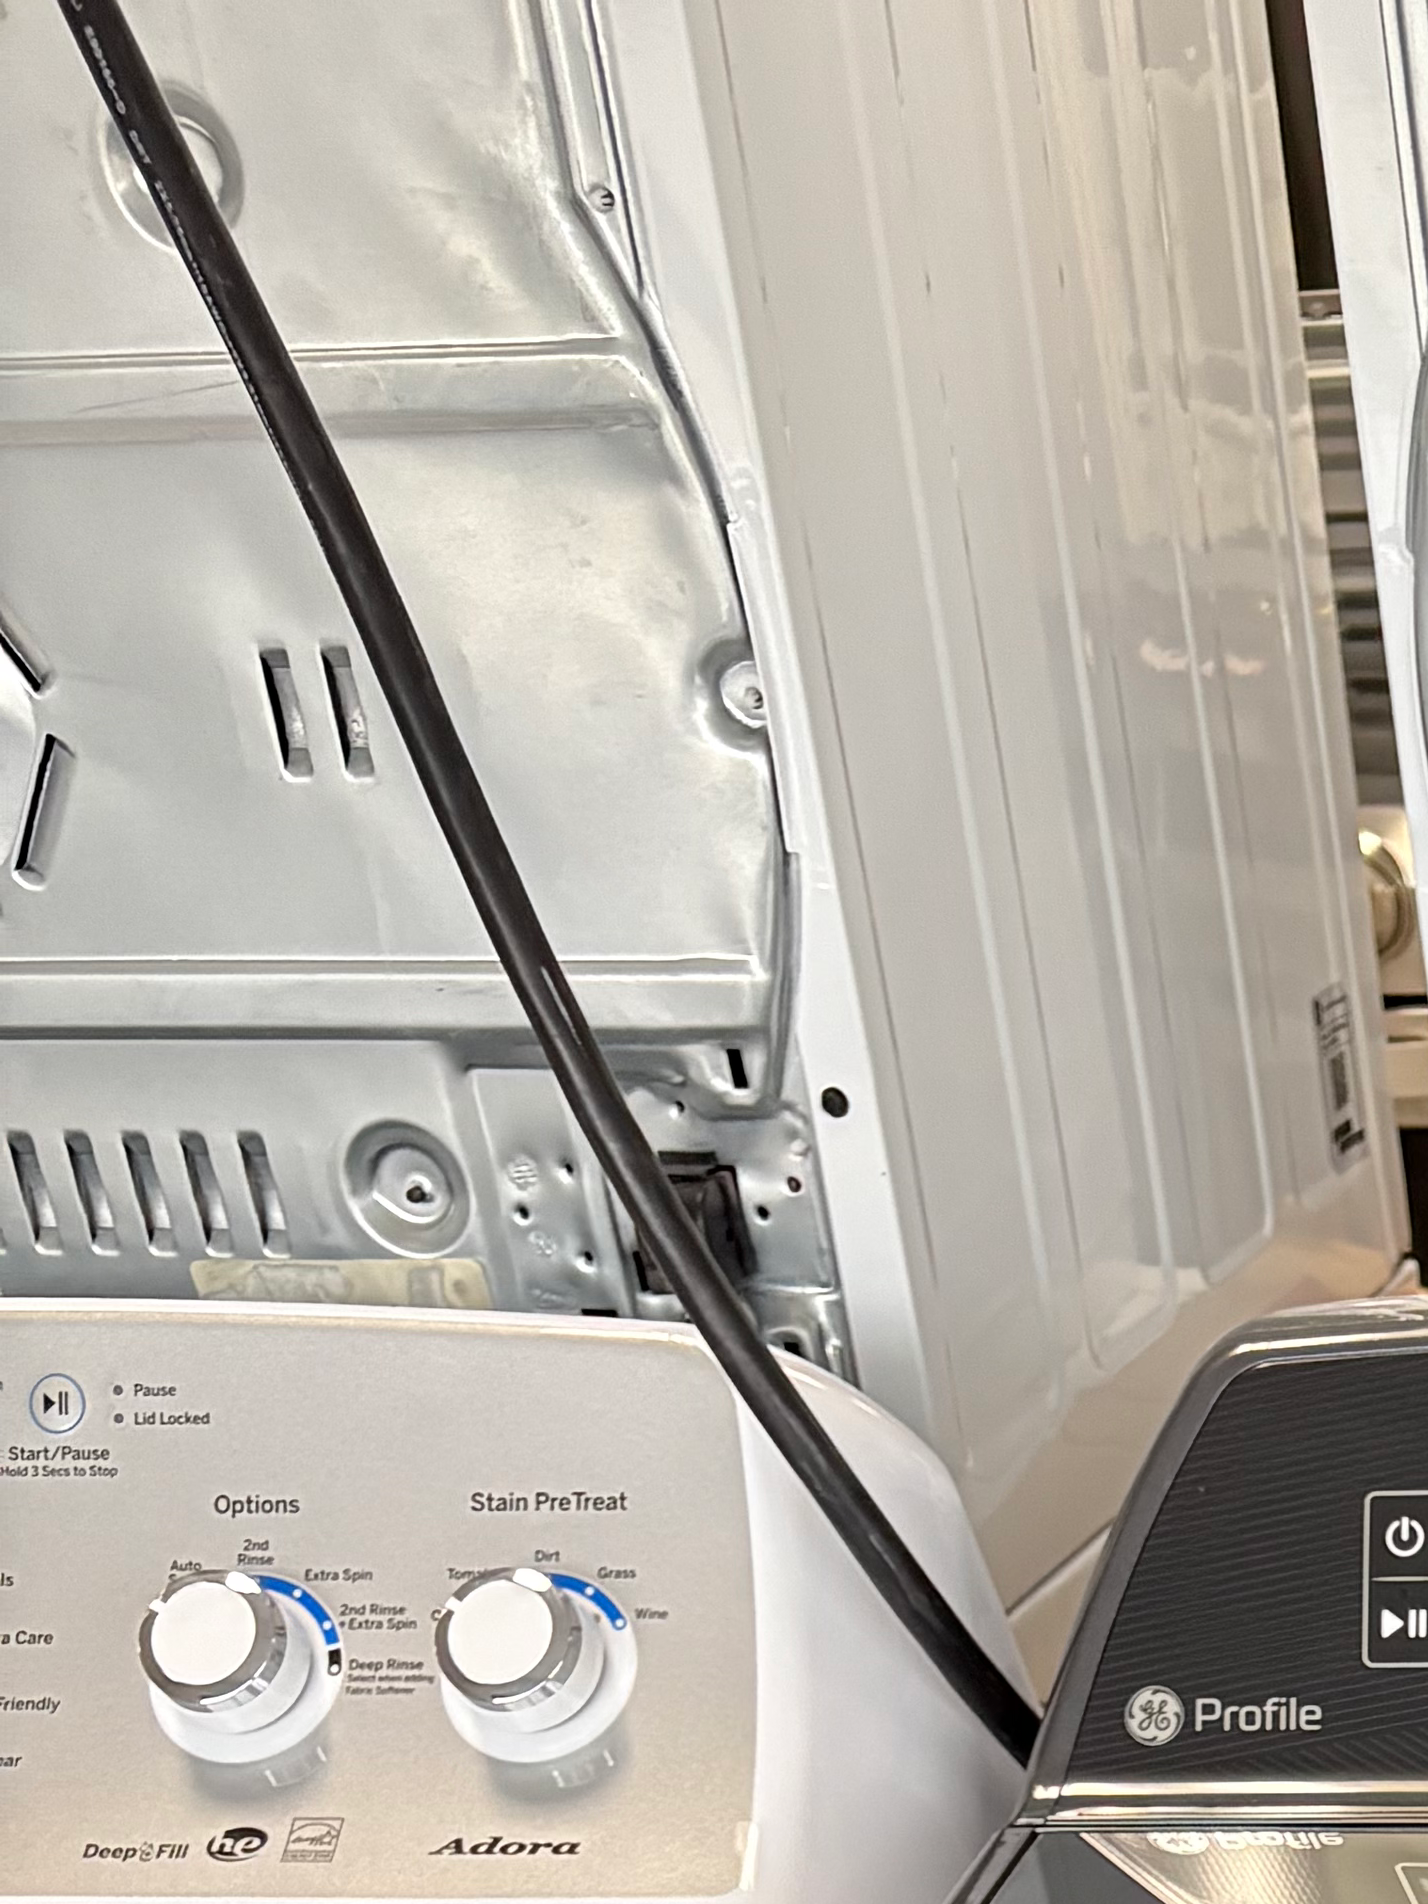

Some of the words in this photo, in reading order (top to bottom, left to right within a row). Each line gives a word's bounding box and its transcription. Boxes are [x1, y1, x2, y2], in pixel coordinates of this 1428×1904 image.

[133, 1383, 177, 1398] Pause
[133, 1412, 156, 1426] Lid
[159, 1411, 211, 1426] Locked
[7, 1445, 111, 1462] Start/Pause
[31, 1466, 39, 1477] 3
[42, 1466, 70, 1478] Secs
[73, 1466, 86, 1477] to
[89, 1465, 119, 1479] Stop
[213, 1494, 301, 1518] Options
[470, 1491, 529, 1512] Stain
[243, 1538, 270, 1552] 2nd
[237, 1553, 275, 1566] Rinse
[534, 1549, 561, 1563] Dirt
[169, 1560, 203, 1573] Auto
[597, 1566, 637, 1580] Grass
[304, 1569, 339, 1582] Extra
[342, 1569, 374, 1584] Spin
[339, 1603, 366, 1616] 2nd
[369, 1603, 407, 1616] Rinse
[634, 1608, 669, 1620] Wine
[347, 1618, 384, 1631] Extra
[386, 1618, 418, 1632] Spin
[15, 1630, 54, 1645] Care
[347, 1659, 384, 1673] Deep
[386, 1659, 424, 1671] Rinse
[1194, 1697, 1323, 1733] Profile
[428, 1835, 581, 1856] Adora
